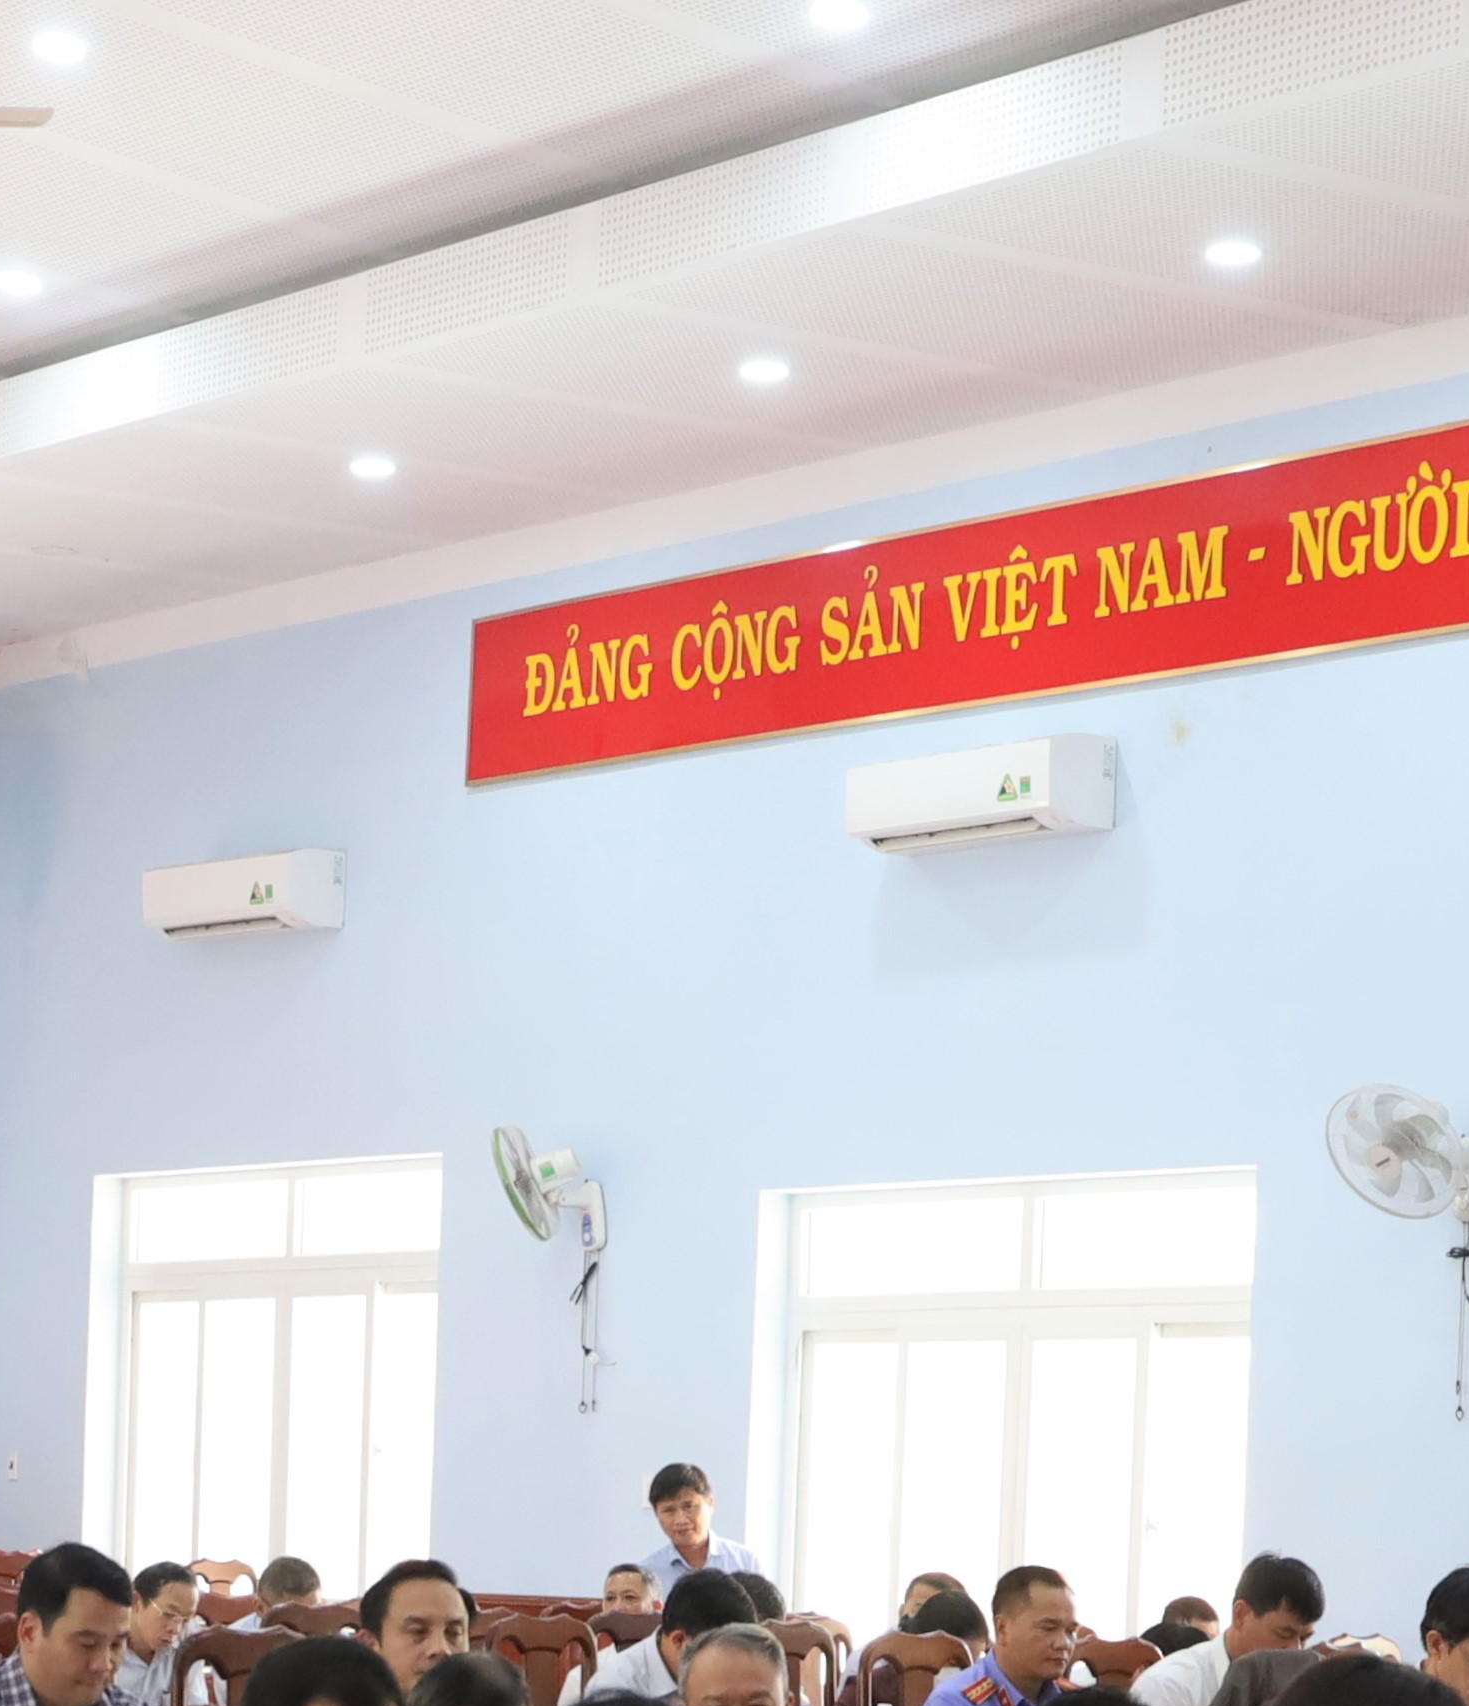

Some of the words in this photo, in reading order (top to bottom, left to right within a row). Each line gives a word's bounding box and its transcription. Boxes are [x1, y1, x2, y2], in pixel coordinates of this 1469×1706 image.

[522, 623, 653, 717] ĐẢNG
[671, 600, 801, 700] CỘNG
[820, 565, 926, 666] SẢN
[942, 544, 1078, 650] VIỆT
[1094, 525, 1229, 618] NAM
